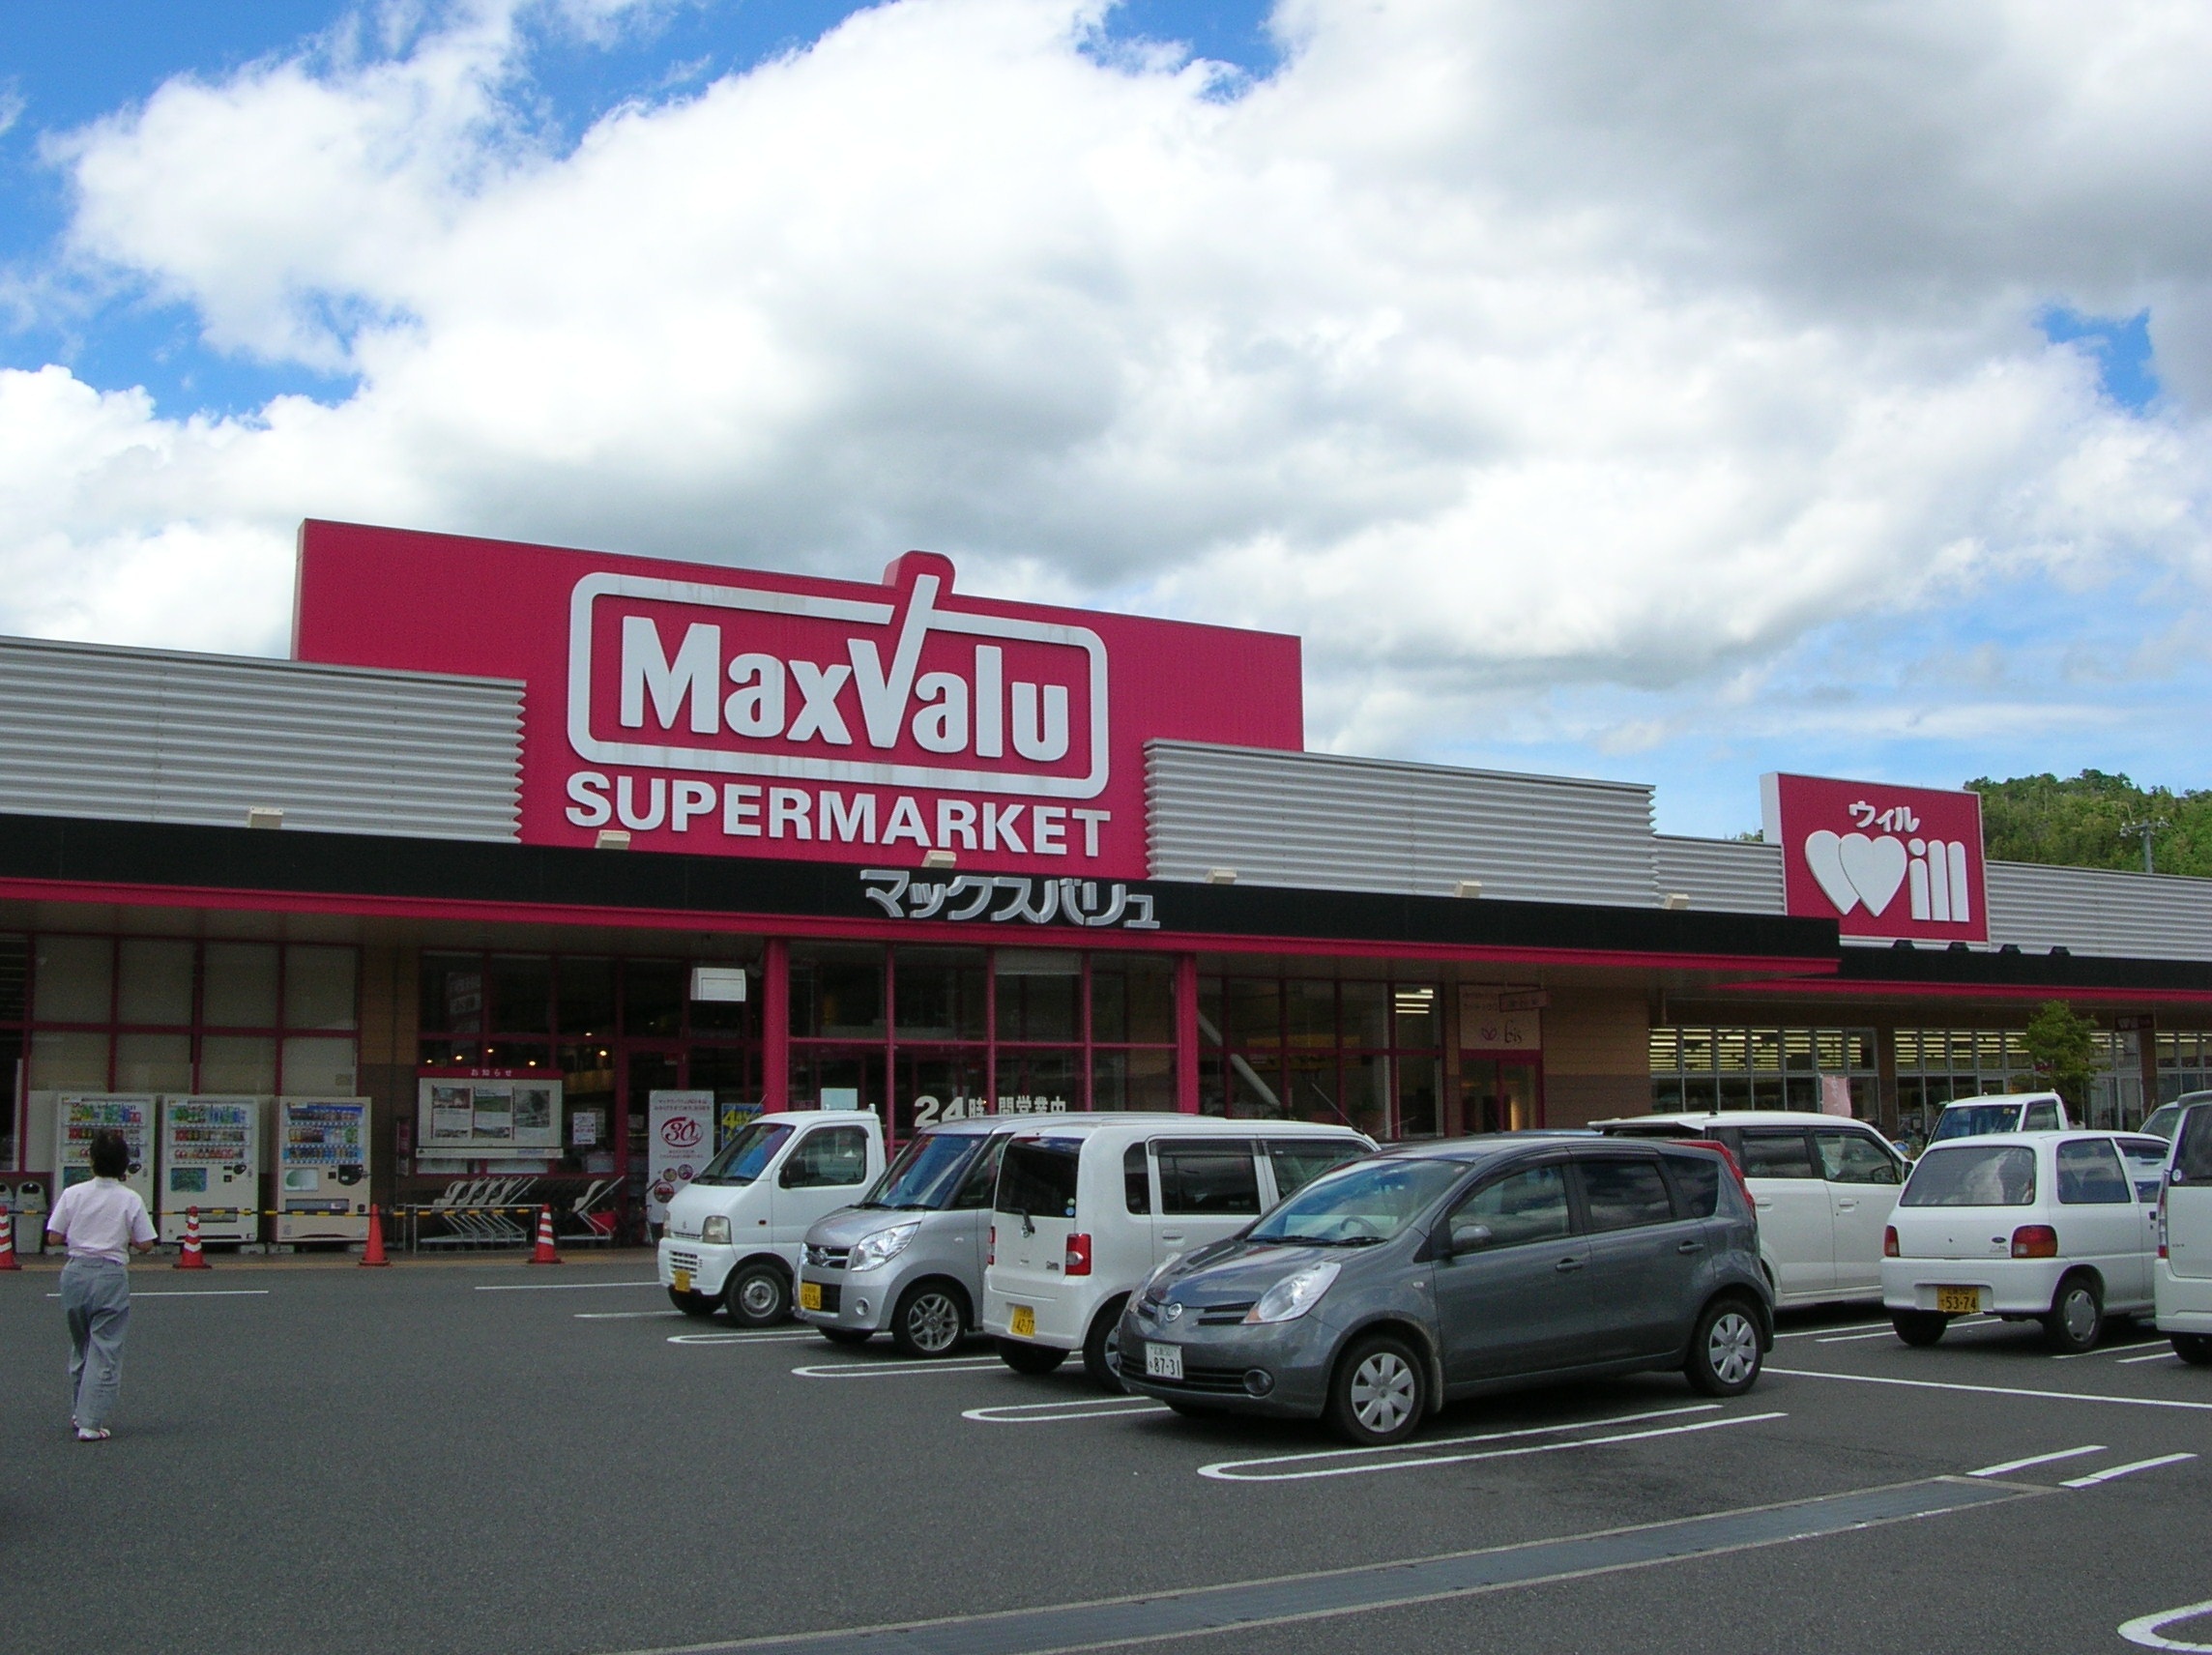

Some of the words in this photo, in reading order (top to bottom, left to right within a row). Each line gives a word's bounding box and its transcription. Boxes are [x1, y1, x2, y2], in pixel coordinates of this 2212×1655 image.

[620, 573, 1068, 763] MaxValu
[565, 771, 1111, 857] SUPERMARKET
[1848, 800, 1920, 832] ウィル
[860, 869, 1160, 930] マックスバリュ
[1153, 1356, 1180, 1376] 87-31
